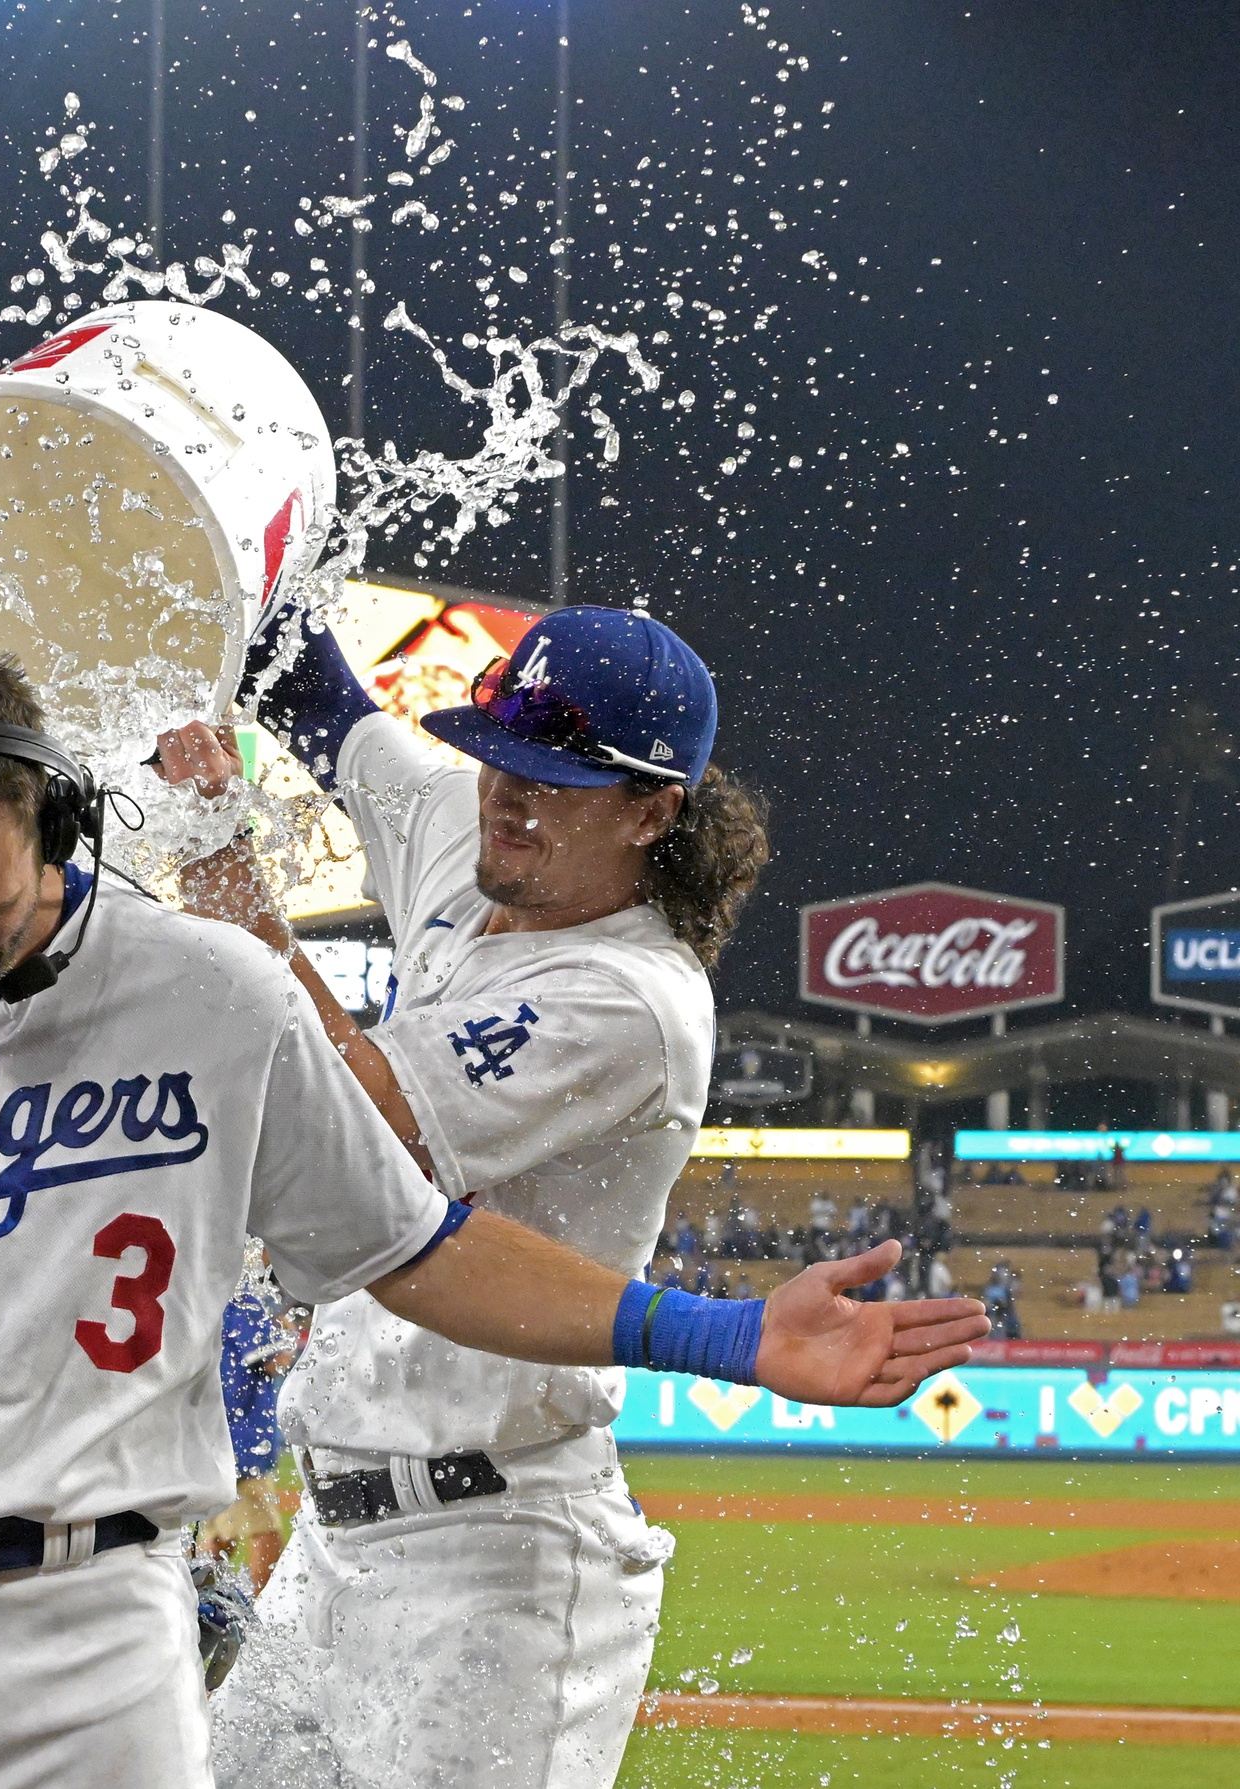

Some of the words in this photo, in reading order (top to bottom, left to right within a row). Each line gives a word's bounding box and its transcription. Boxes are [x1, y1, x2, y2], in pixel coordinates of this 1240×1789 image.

[513, 635, 552, 691] LA
[1173, 937, 1240, 970] UCL
[447, 1003, 539, 1085] LA
[74, 1212, 176, 1373] 3
[659, 1379, 675, 1427] I
[1039, 1385, 1056, 1434] I
